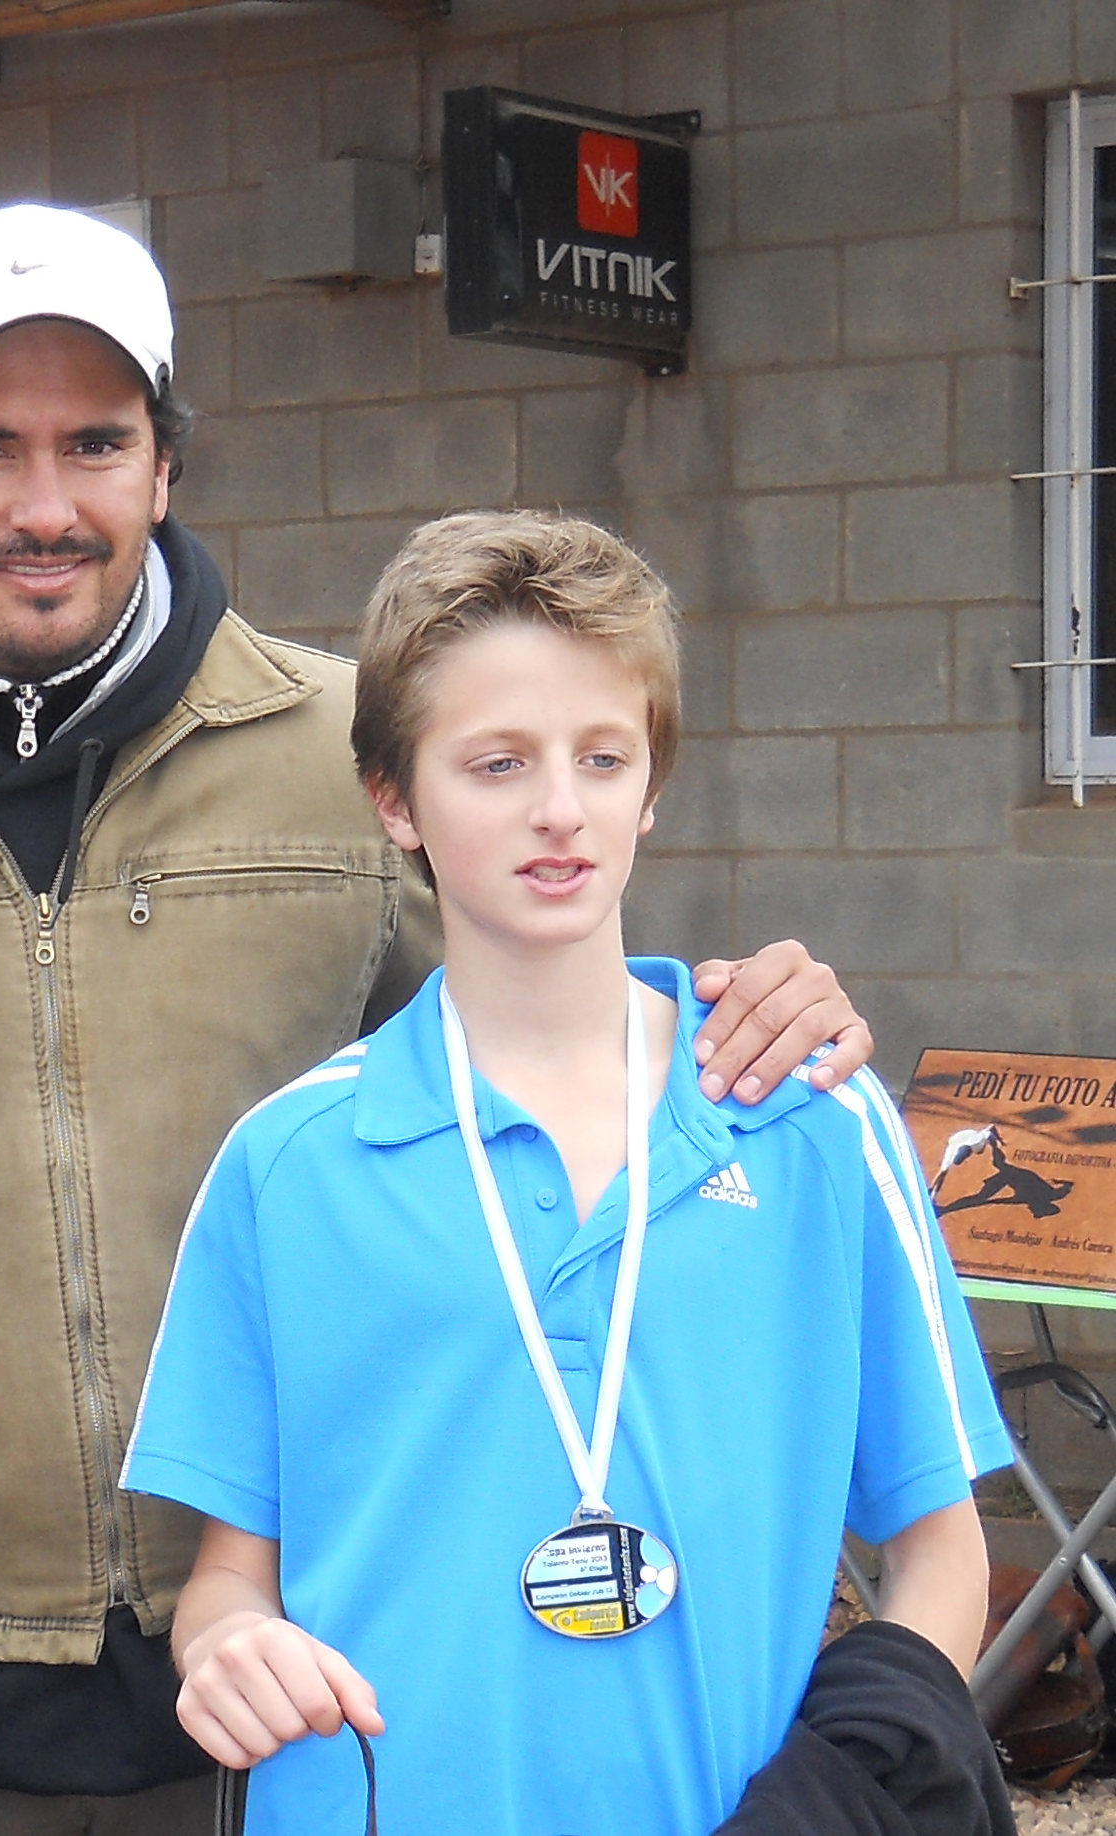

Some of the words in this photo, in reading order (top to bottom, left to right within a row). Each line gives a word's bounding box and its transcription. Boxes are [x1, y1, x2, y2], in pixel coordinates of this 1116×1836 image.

[536, 238, 677, 302] VITNIK
[540, 291, 619, 318] FITNESS
[632, 308, 678, 326] WEAR
[953, 1067, 1011, 1100] PEDÍ
[1009, 1073, 1041, 1102] TU
[1039, 1076, 1100, 1107] FOTO
[698, 1185, 758, 1209] adidas
